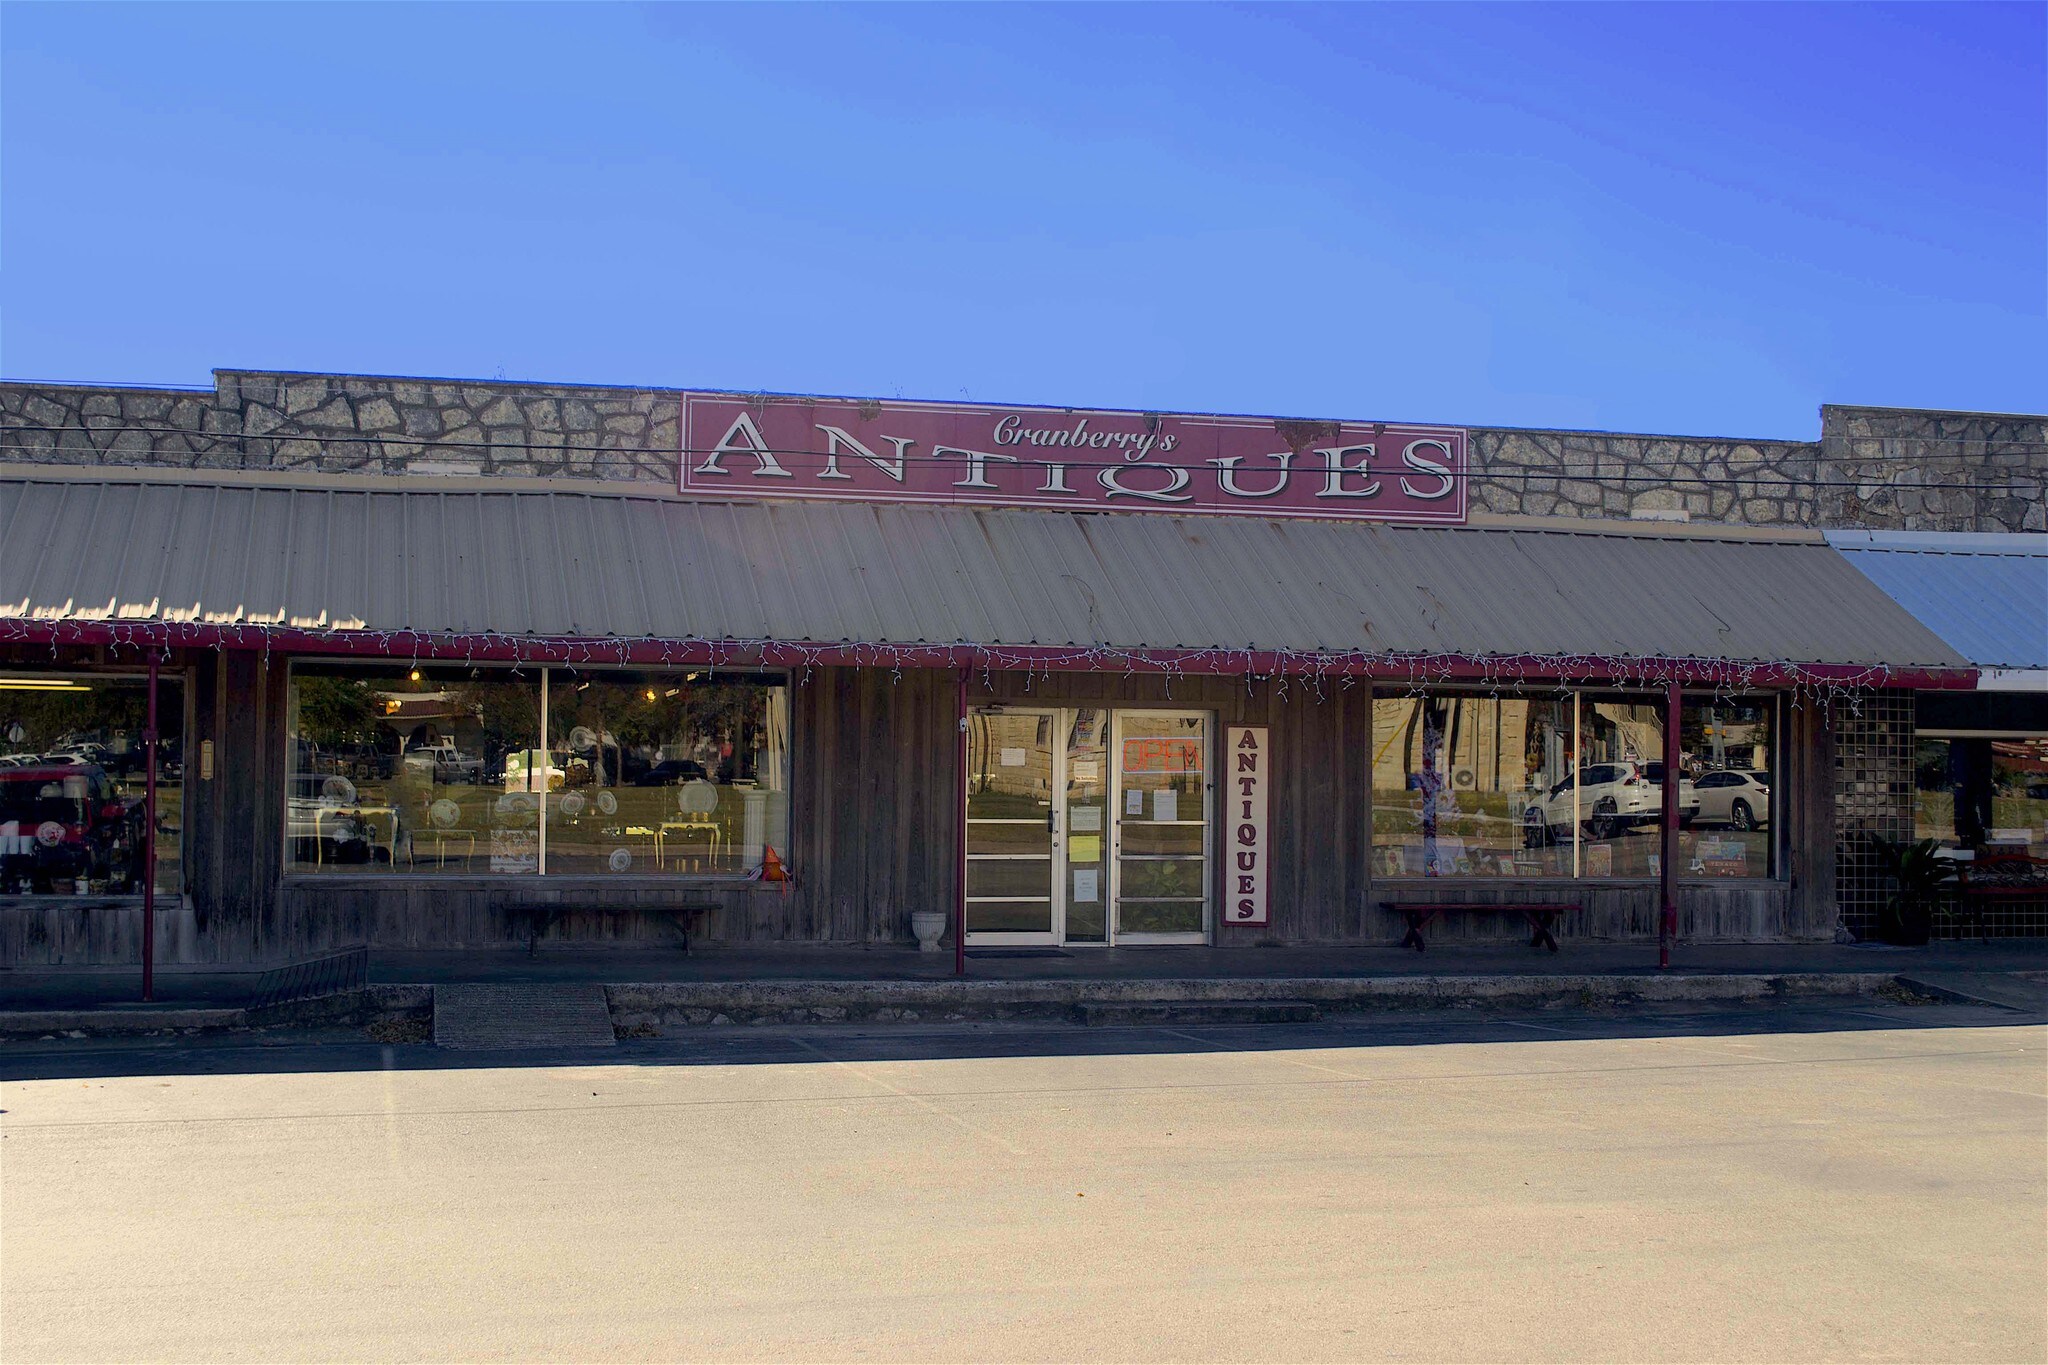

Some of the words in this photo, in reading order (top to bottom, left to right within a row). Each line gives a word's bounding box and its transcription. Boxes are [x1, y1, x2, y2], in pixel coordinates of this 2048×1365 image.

[693, 410, 1455, 502] ANTIQUES
[993, 414, 1178, 462] Cranberry's
[1237, 730, 1258, 919] ANTIQUES
